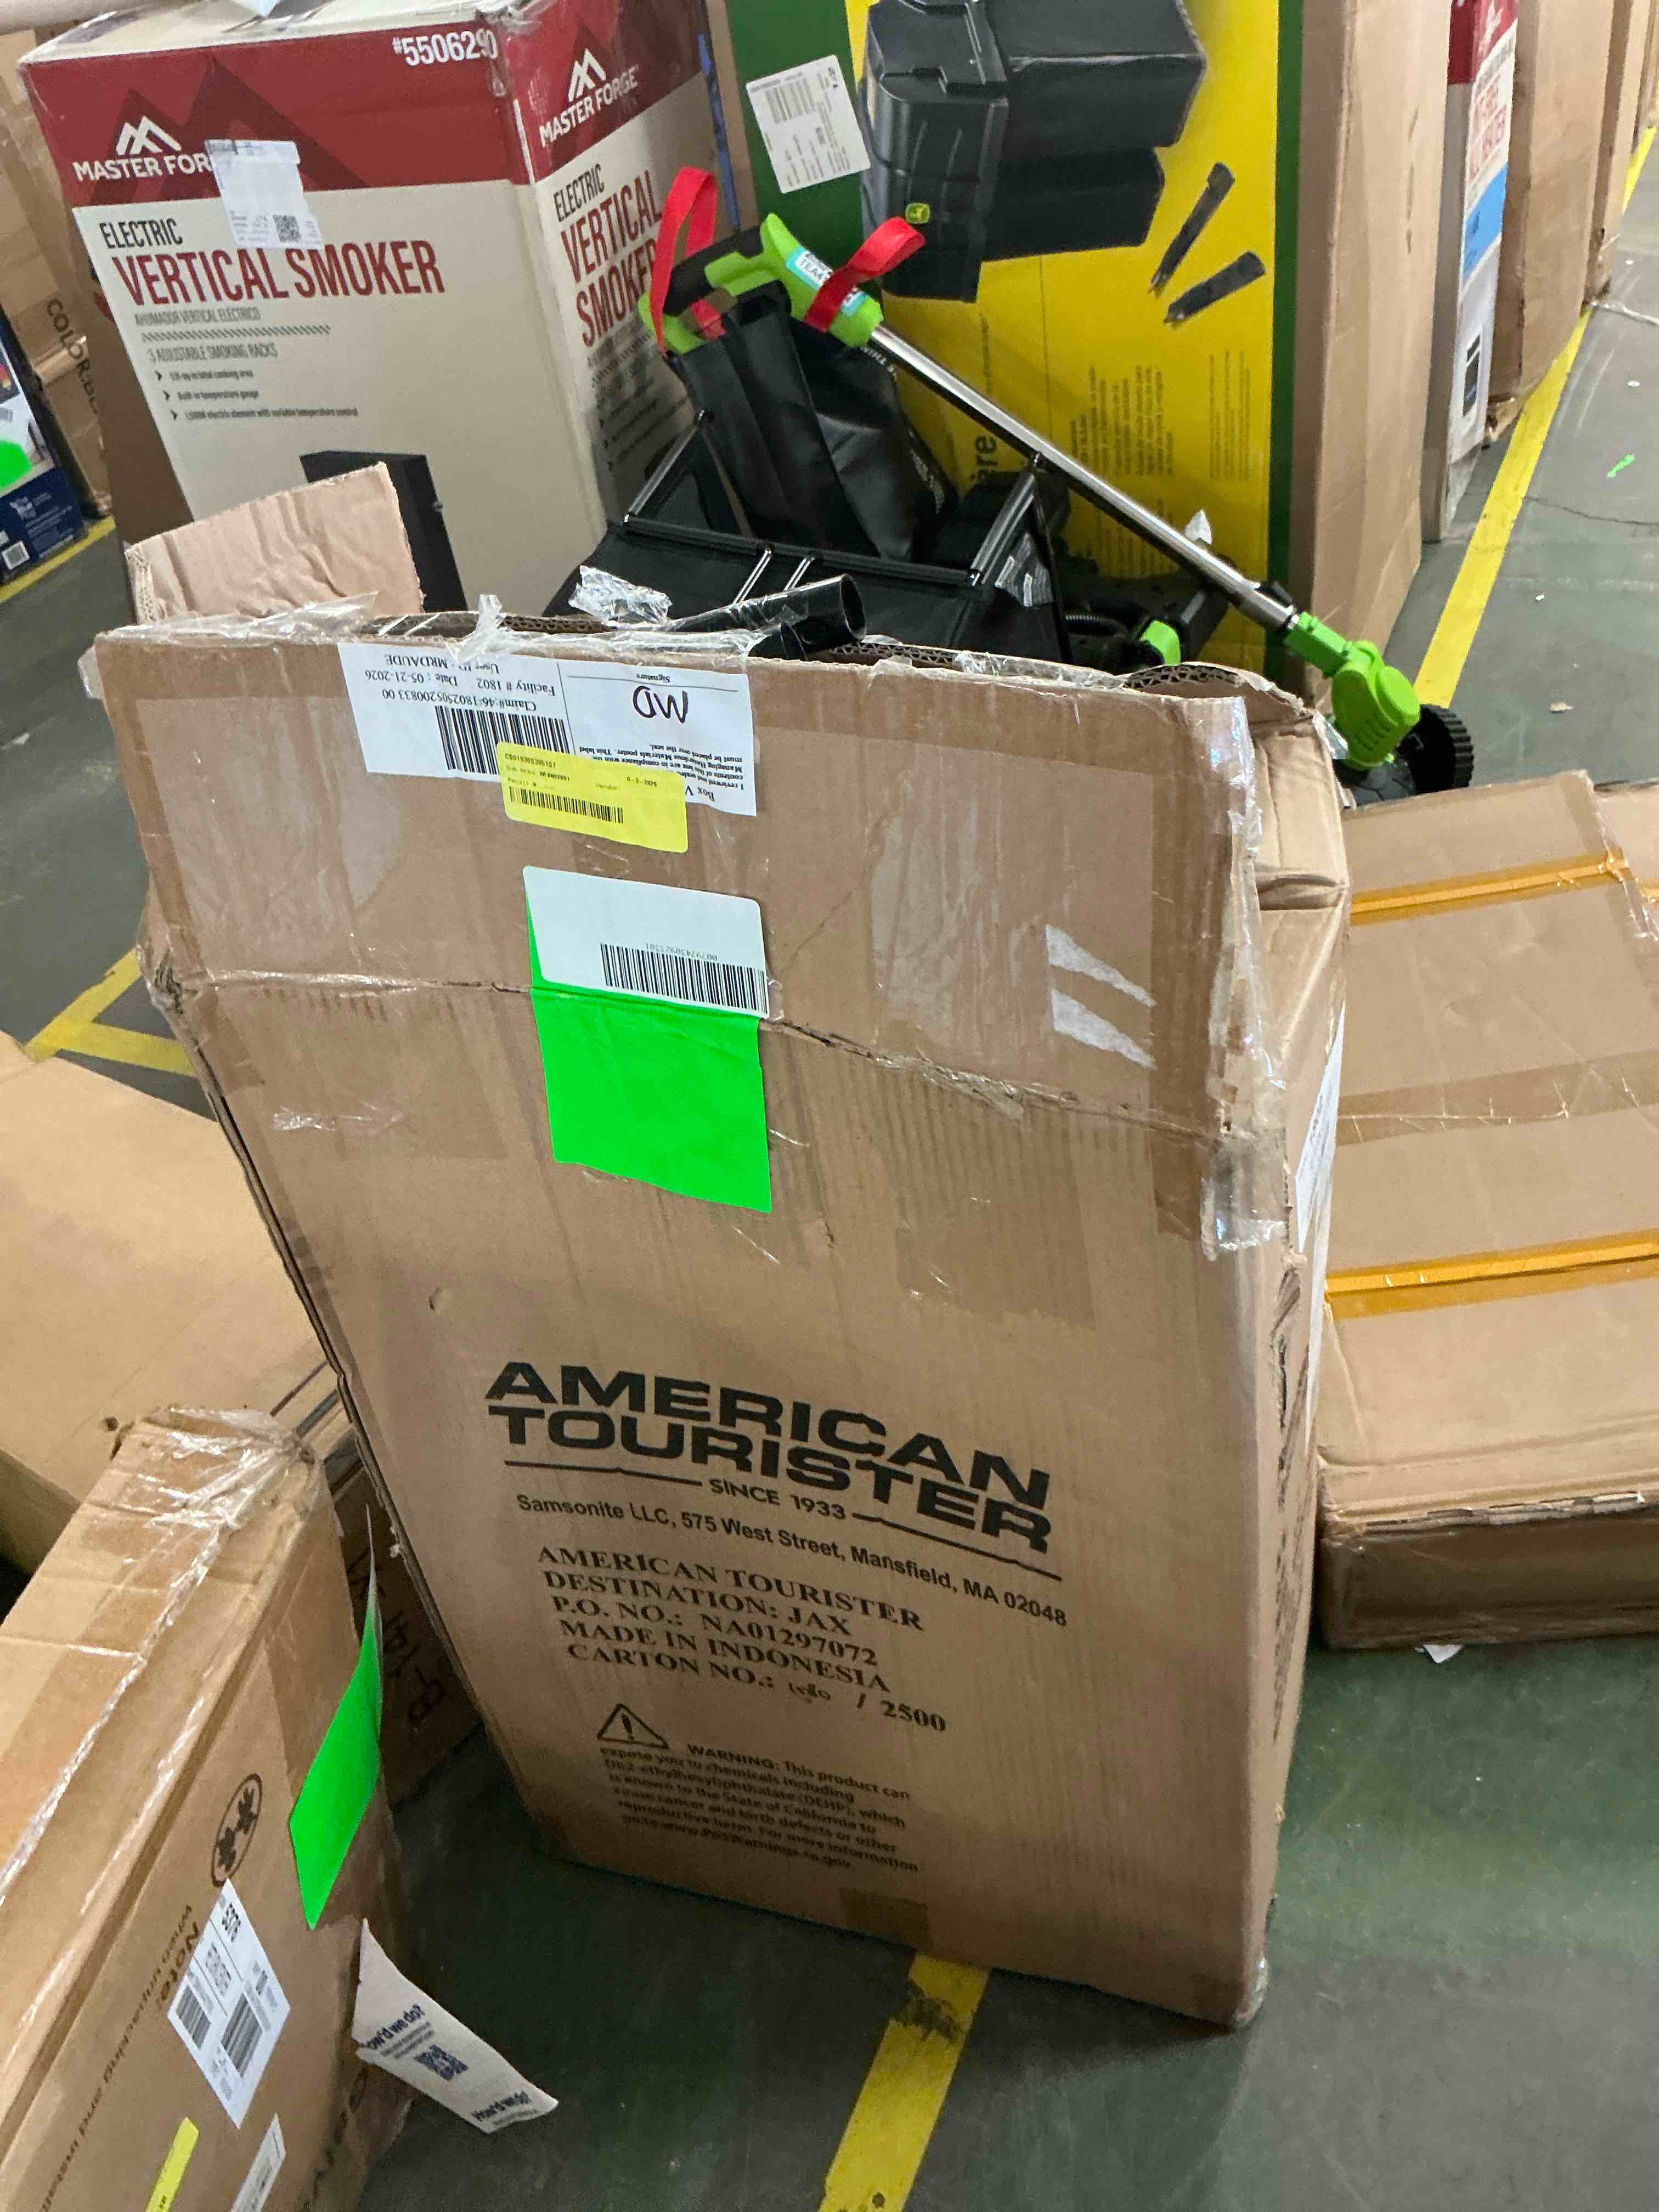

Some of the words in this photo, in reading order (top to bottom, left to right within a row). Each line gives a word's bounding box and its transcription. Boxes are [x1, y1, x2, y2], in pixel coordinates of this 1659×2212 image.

[539, 98, 596, 148] MASTER
[594, 65, 639, 114] FORGE
[72, 157, 161, 182] MASTER
[166, 151, 215, 176] FOR
[553, 163, 605, 223] ELECTRIC
[99, 218, 183, 249] ELECTRIC
[560, 170, 662, 284] VERTICAL
[112, 247, 290, 306] VERTICAL
[284, 239, 445, 298] SMOKER
[182, 309, 217, 324] VERTICAL
[157, 346, 207, 363] ADJUSTABLE
[207, 343, 248, 360] SMOKING
[247, 342, 278, 359] RACKS
[385, 654, 448, 669] MRDAUDE
[365, 670, 424, 684] 05-21-2026
[435, 674, 459, 687] Date
[477, 678, 503, 690] 1802
[506, 681, 512, 690] #
[516, 682, 555, 697] Facility
[636, 673, 670, 685] Signature
[579, 746, 596, 754] label
[621, 758, 661, 767] compliance
[638, 751, 673, 761] Materials
[707, 762, 742, 773] Managing
[698, 787, 715, 803] Box
[484, 1360, 1051, 1512] AMERICAN
[487, 1404, 1052, 1554] TOURISTER
[709, 1477, 780, 1507] SINCE
[790, 1494, 847, 1521] 1933
[517, 1494, 624, 1520] Samsonite
[631, 1505, 677, 1530] LLC,
[681, 1511, 718, 1533] 575
[720, 1517, 774, 1545] West
[777, 1527, 846, 1562] Street,
[850, 1545, 958, 1594] Mansfield,
[962, 1576, 1000, 1604] MA
[1002, 1590, 1066, 1628] 02048
[538, 1545, 718, 1584] AMERICAN
[725, 1568, 927, 1632] TOURISTER
[544, 1570, 778, 1621] DESTINATION:
[788, 1606, 854, 1638] JAX
[552, 1595, 610, 1618] P.O.
[618, 1602, 684, 1627] NO.:
[702, 1613, 878, 1667] NA01297072
[560, 1619, 656, 1645] MADE
[666, 1631, 697, 1652] IN
[709, 1635, 891, 1693] INDONESIA
[567, 1644, 700, 1677] CARTON
[709, 1660, 774, 1689] NO.:
[882, 1700, 947, 1733] 2500
[687, 1743, 780, 1770] WARNING:
[785, 1760, 814, 1778] This
[817, 1771, 879, 1794] product
[882, 1787, 911, 1801] can
[783, 1776, 855, 1804] including
[859, 1808, 906, 1829] which
[828, 1843, 919, 1872] information
[855, 1836, 898, 1853] other
